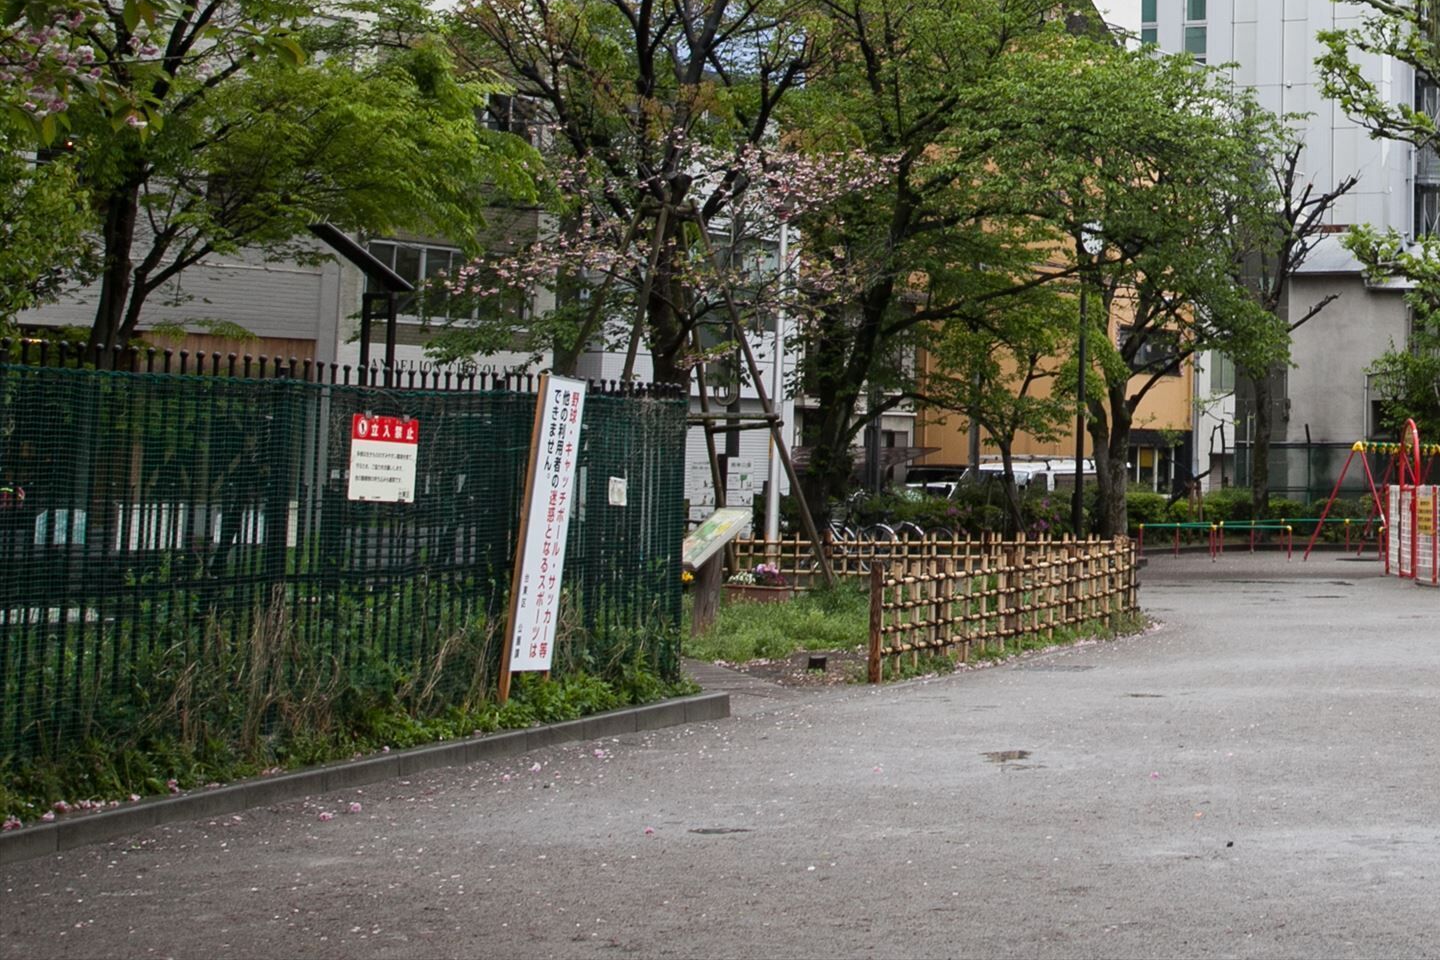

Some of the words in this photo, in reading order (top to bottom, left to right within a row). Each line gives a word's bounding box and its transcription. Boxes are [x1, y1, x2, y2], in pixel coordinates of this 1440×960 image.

[371, 423, 414, 440] 立入禁止
[544, 389, 562, 479] できません。
